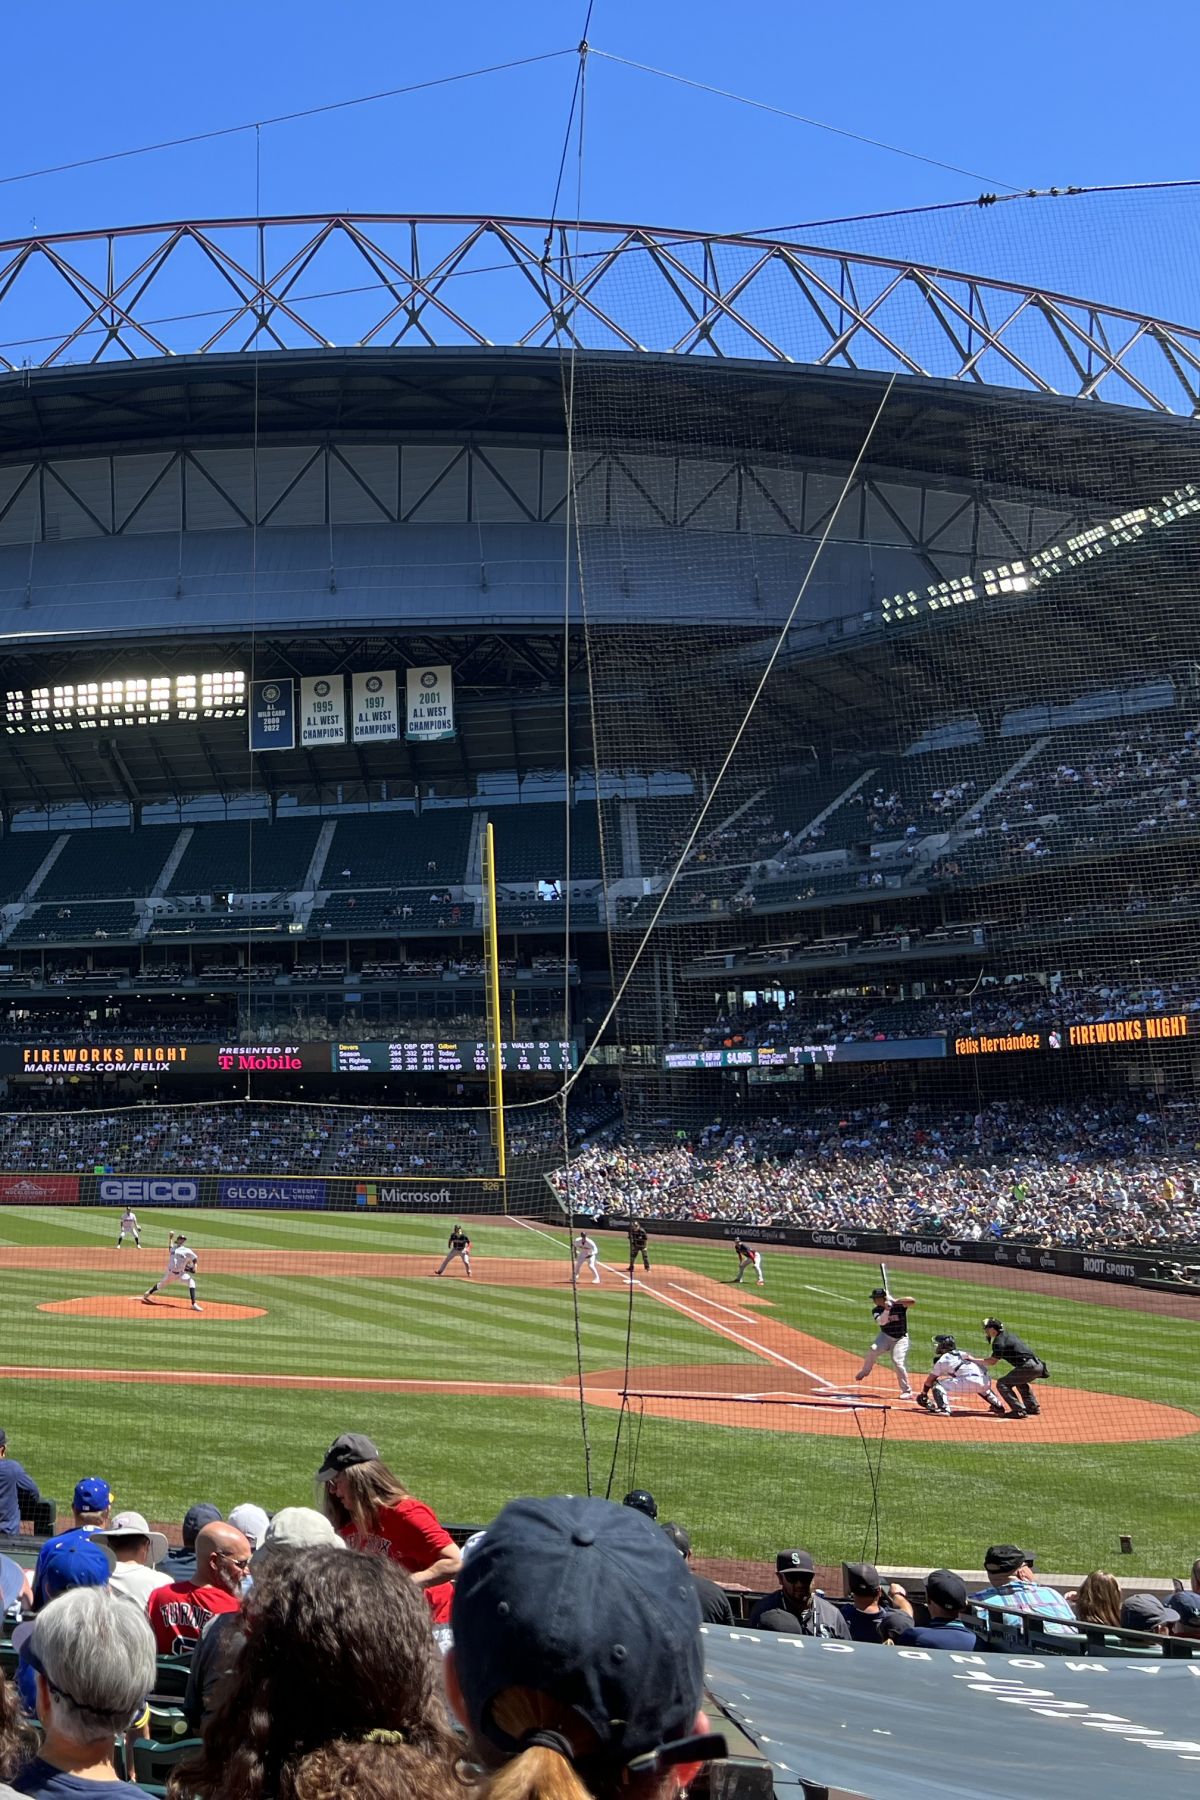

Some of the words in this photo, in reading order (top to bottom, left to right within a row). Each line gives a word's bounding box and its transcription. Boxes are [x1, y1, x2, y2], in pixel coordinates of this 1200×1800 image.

[365, 697, 384, 709] 1997
[419, 693, 440, 704] 2001
[313, 701, 333, 713] 1995
[413, 708, 425, 718] A.L.
[427, 707, 447, 717] WEST
[307, 717, 318, 726] A.L.
[320, 715, 339, 725] WEST
[359, 713, 371, 723] A.L.
[372, 711, 391, 721] WEST
[355, 724, 396, 735] CHAMPIONS
[409, 719, 452, 732] CHAMPIONS
[303, 728, 343, 739] CHAMPIONS
[1069, 1020, 1142, 1046] FIREWORKS
[1147, 1016, 1187, 1039] NIGHT
[956, 1037, 979, 1055] Félix
[980, 1033, 1040, 1053] Hernández
[24, 1049, 124, 1063] FIREWORKS
[134, 1048, 187, 1061] NIGHT
[24, 1062, 170, 1072] MARINERS.COM/FELIX
[238, 1055, 302, 1070] Mobile
[100, 1181, 197, 1201] GEICO
[482, 1182, 499, 1191] 326
[228, 1187, 289, 1200] GLOBAL
[381, 1188, 451, 1203] Microsoft
[812, 1231, 836, 1244] Great
[837, 1233, 856, 1249] Clips
[900, 1240, 939, 1255] KeyBank
[1084, 1258, 1105, 1273] ROOT
[1106, 1262, 1135, 1277] SPORTS
[160, 1602, 212, 1630] TURNE
